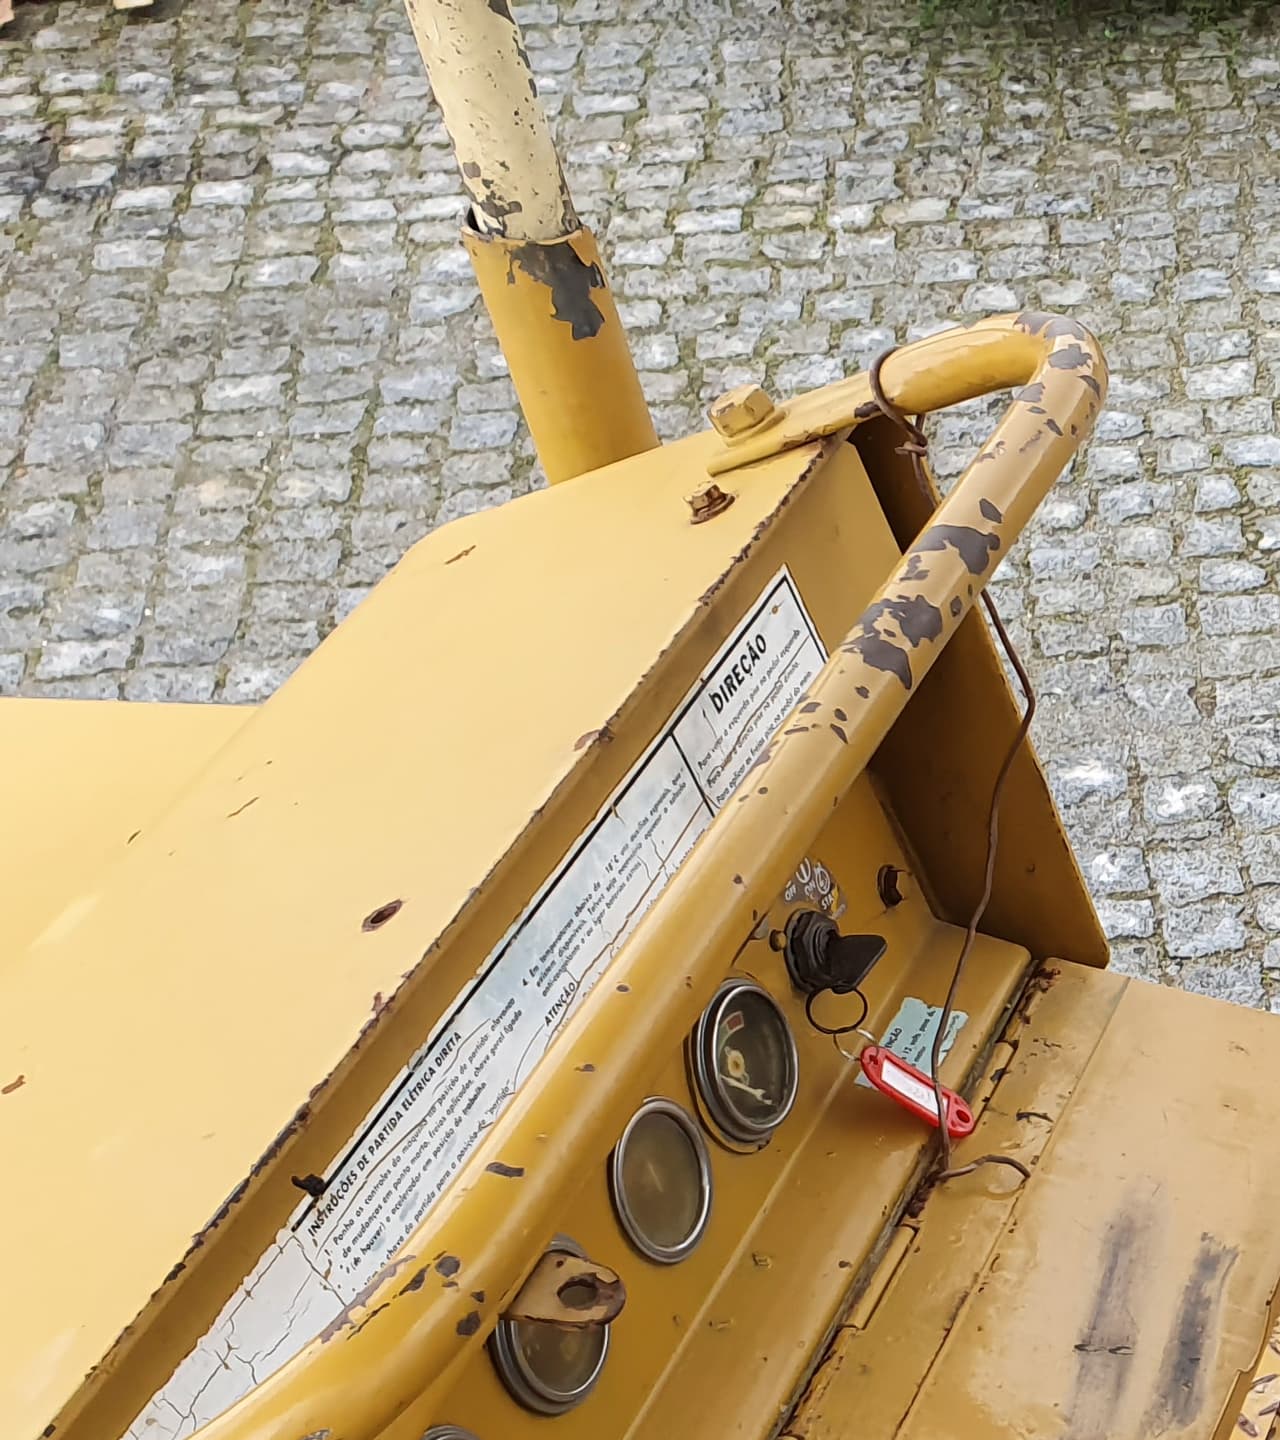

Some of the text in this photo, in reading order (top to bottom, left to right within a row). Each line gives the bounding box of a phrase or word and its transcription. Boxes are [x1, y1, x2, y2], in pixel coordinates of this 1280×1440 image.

[708, 629, 769, 716] DIREÇÃO
[784, 884, 797, 901] OFF
[542, 979, 576, 1028] ATENÇÃO
[306, 1028, 462, 1240] INSTRUÇÕES DE PARTIDA ELÉTRICA DIRETA
[332, 1214, 354, 1247] Ponha
[362, 1165, 391, 1206] controles
[458, 1060, 467, 1076] de
[340, 1242, 351, 1259] de
[350, 1200, 383, 1247] mudanças
[381, 1187, 393, 1204] em
[392, 1162, 411, 1191] ponto
[427, 1112, 446, 1139] freios
[472, 1051, 490, 1078] chave
[488, 1030, 506, 1057] geral
[359, 1219, 386, 1257] houver)
[389, 1169, 422, 1216] acelerador
[421, 1156, 432, 1172] em
[431, 1125, 455, 1159] posição
[452, 1112, 463, 1128] de
[460, 1078, 487, 1116] trabalho
[412, 1187, 436, 1223] partida
[435, 1167, 452, 1192] para
